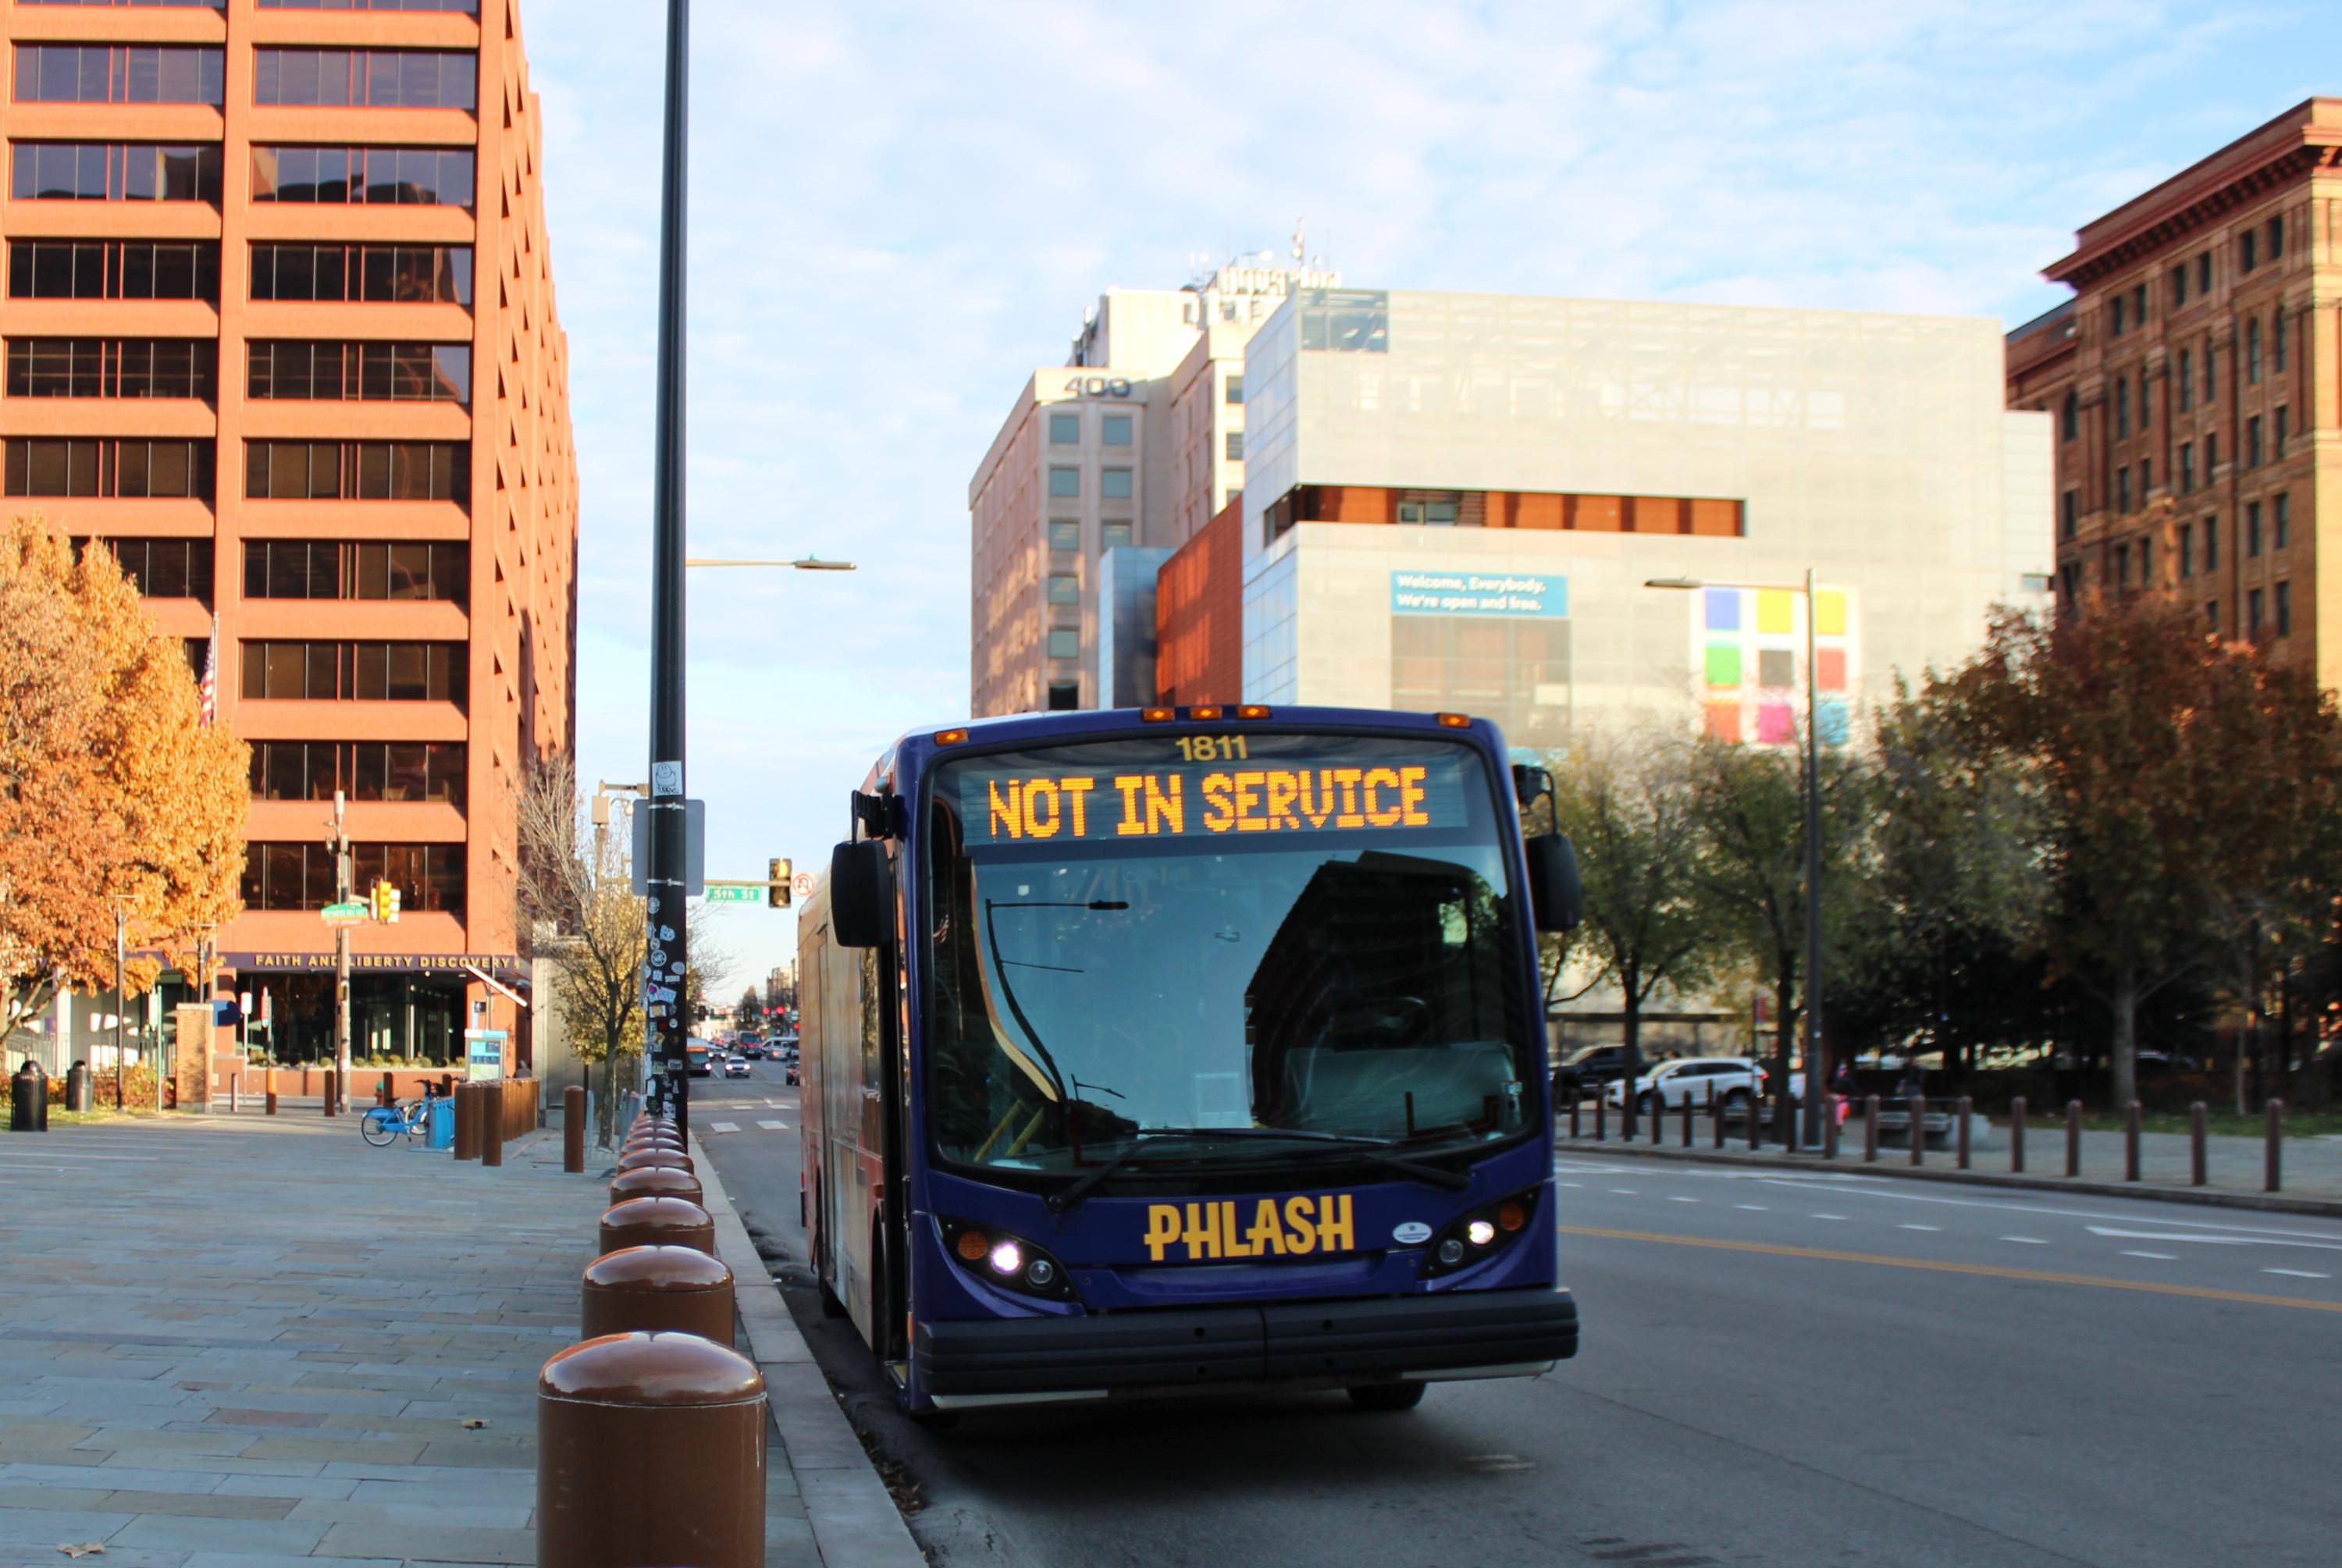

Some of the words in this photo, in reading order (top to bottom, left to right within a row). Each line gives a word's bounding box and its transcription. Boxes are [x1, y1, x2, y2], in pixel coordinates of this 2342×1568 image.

[1398, 575, 1466, 591] Welcome,
[1470, 578, 1545, 594] Everybody.
[1398, 594, 1439, 608] We're
[1443, 597, 1478, 611] open
[1480, 596, 1507, 609] and
[1511, 597, 1541, 611] free.
[1176, 735, 1248, 761] 1811
[988, 777, 1094, 838] NOT
[1114, 773, 1184, 835] IN
[1201, 766, 1429, 832] SERVICE
[714, 889, 735, 900] 5th
[741, 890, 754, 900] St
[255, 955, 301, 966] FAITH
[419, 956, 510, 969] DISCOVERY
[1144, 1195, 1354, 1261] PHLASH
